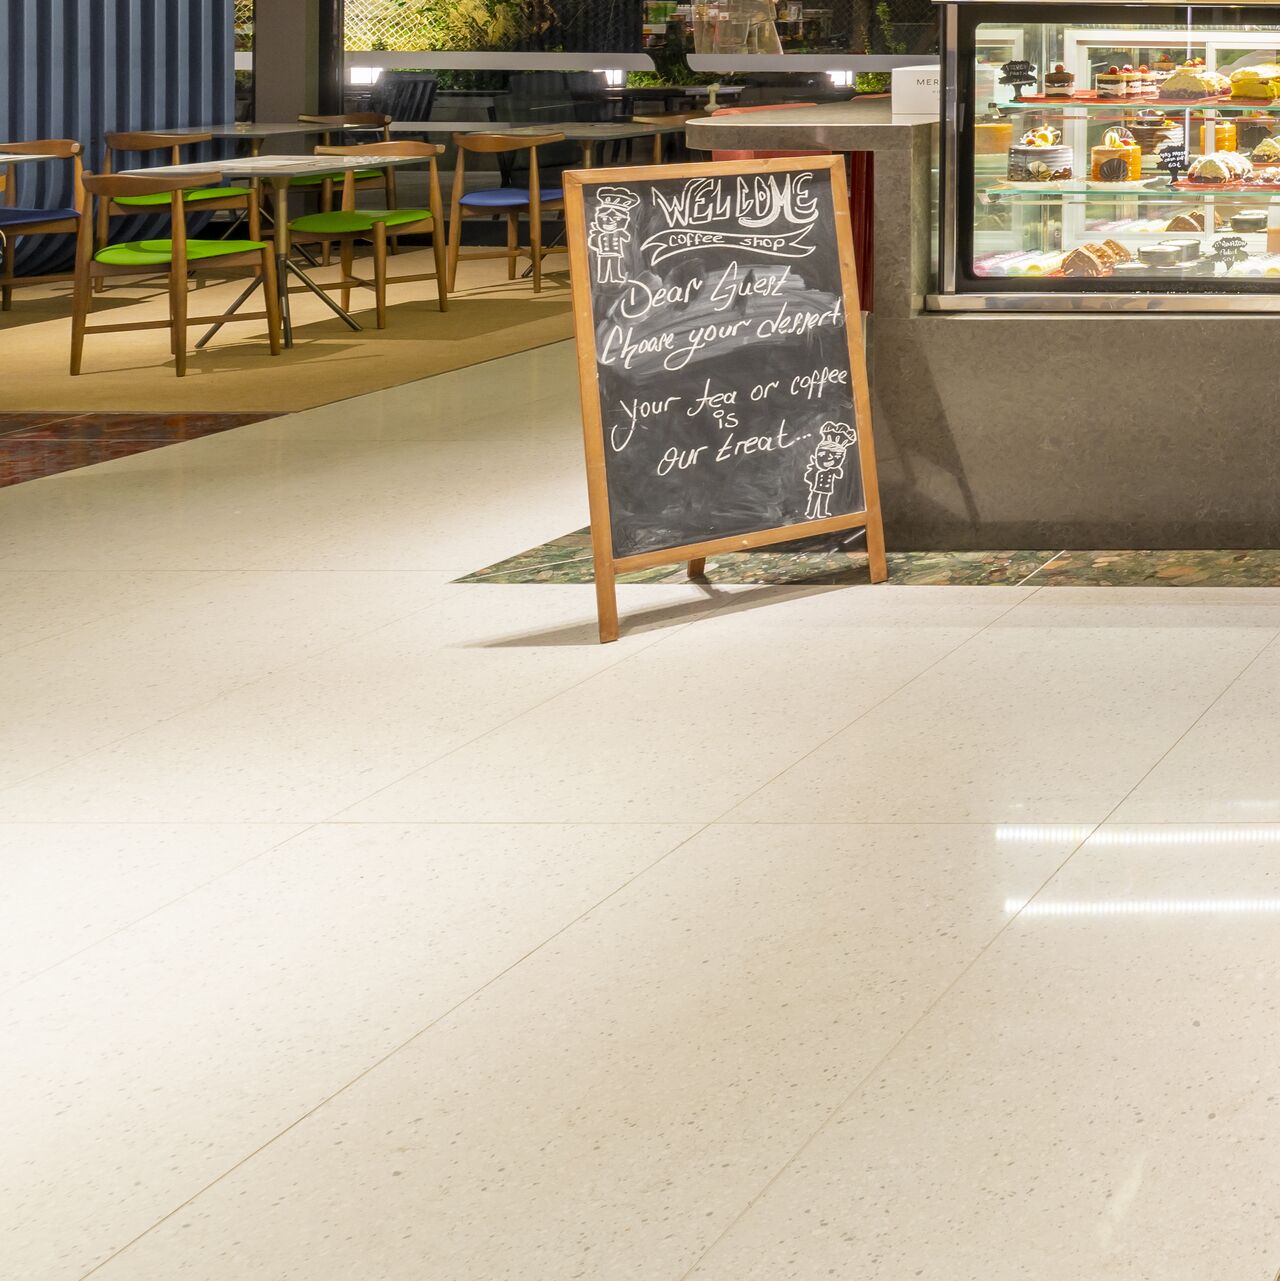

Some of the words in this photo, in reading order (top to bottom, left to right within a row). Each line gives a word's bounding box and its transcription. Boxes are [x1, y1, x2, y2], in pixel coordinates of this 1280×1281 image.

[651, 172, 819, 228] WELCOME
[669, 233, 725, 247] coffee
[740, 237, 785, 251] shop
[621, 278, 702, 318] Dear
[711, 261, 791, 311] Guest
[664, 320, 751, 370] your
[757, 297, 841, 337] dessert
[611, 397, 681, 452] your
[687, 378, 737, 416] tea
[751, 381, 779, 401] or
[790, 367, 847, 400] coffee
[713, 410, 739, 429] is
[657, 446, 708, 476] our
